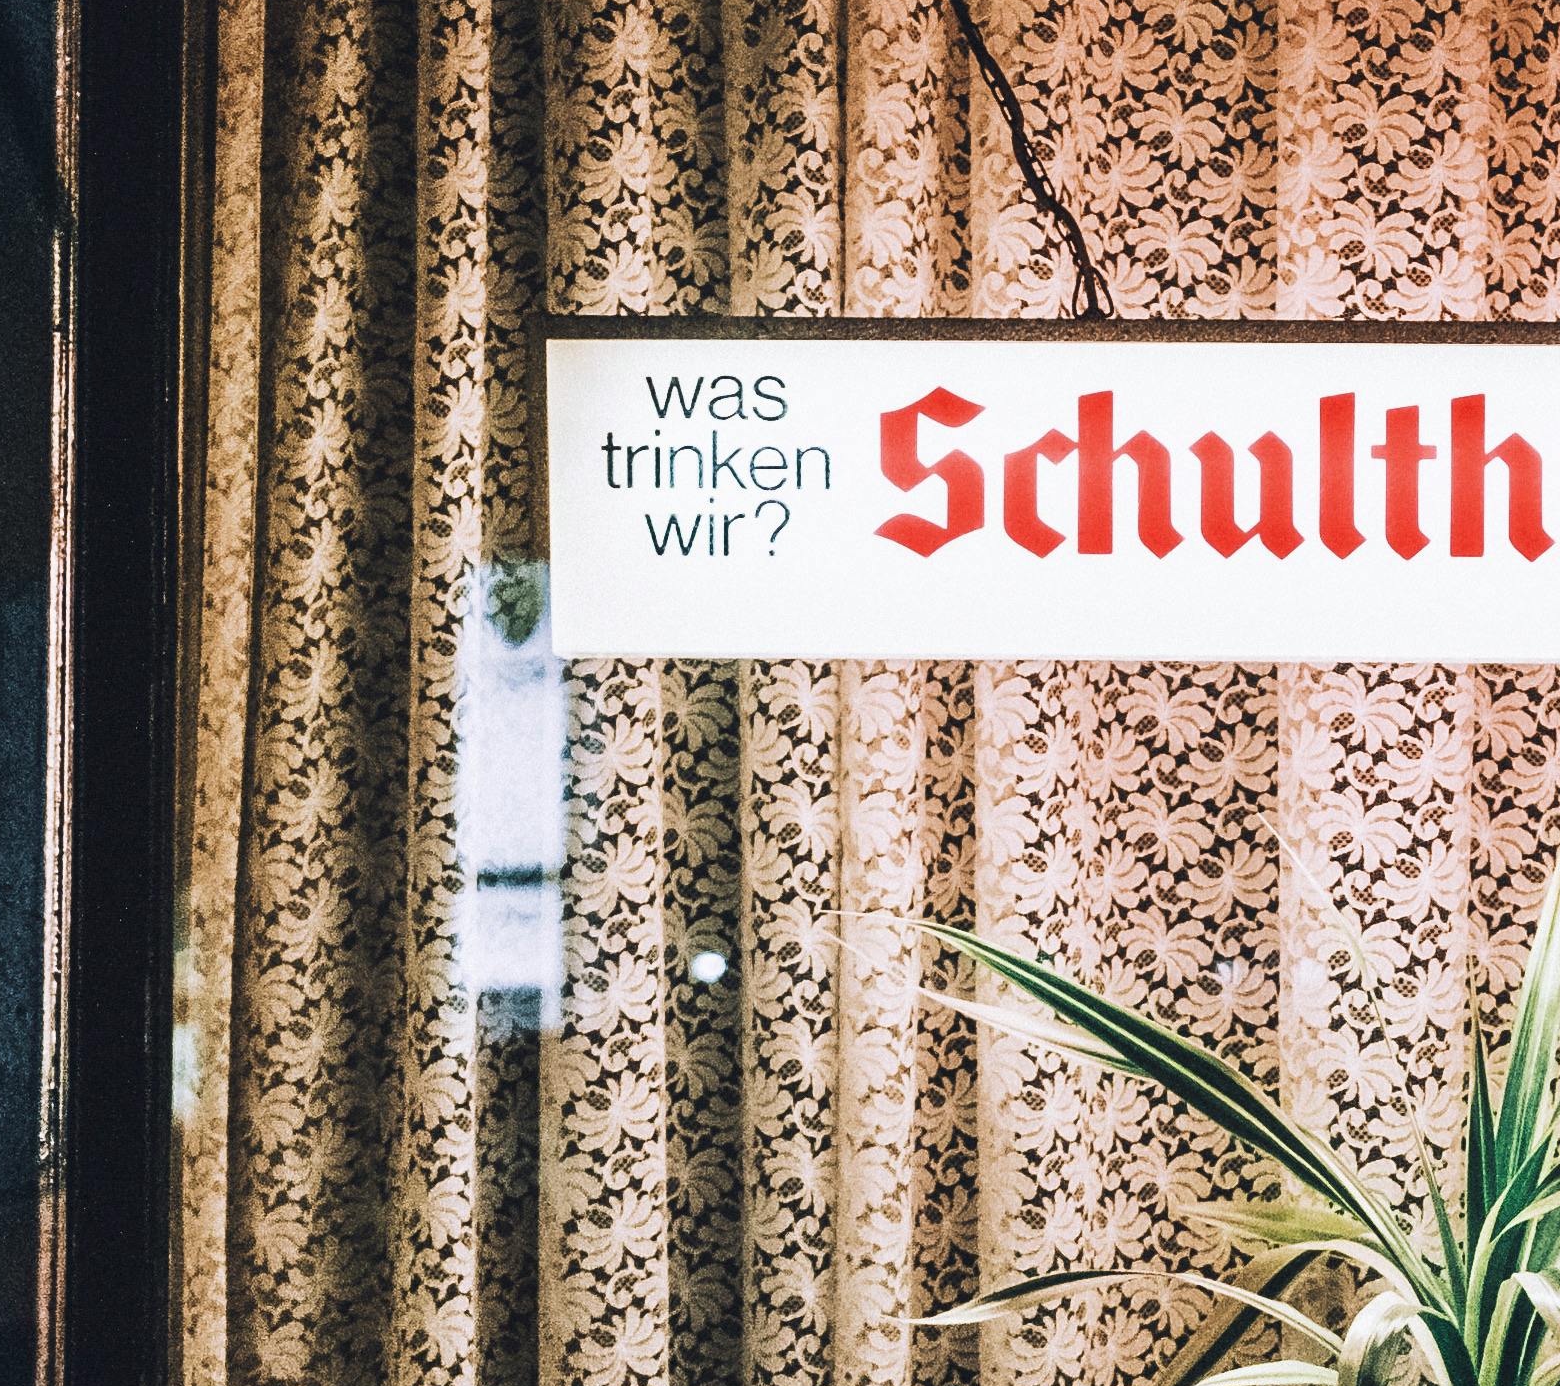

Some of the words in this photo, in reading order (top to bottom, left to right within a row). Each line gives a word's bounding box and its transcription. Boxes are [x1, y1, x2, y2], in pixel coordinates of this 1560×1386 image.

[645, 374, 788, 422] was
[600, 428, 831, 491] trinken
[644, 496, 791, 557] wir?
